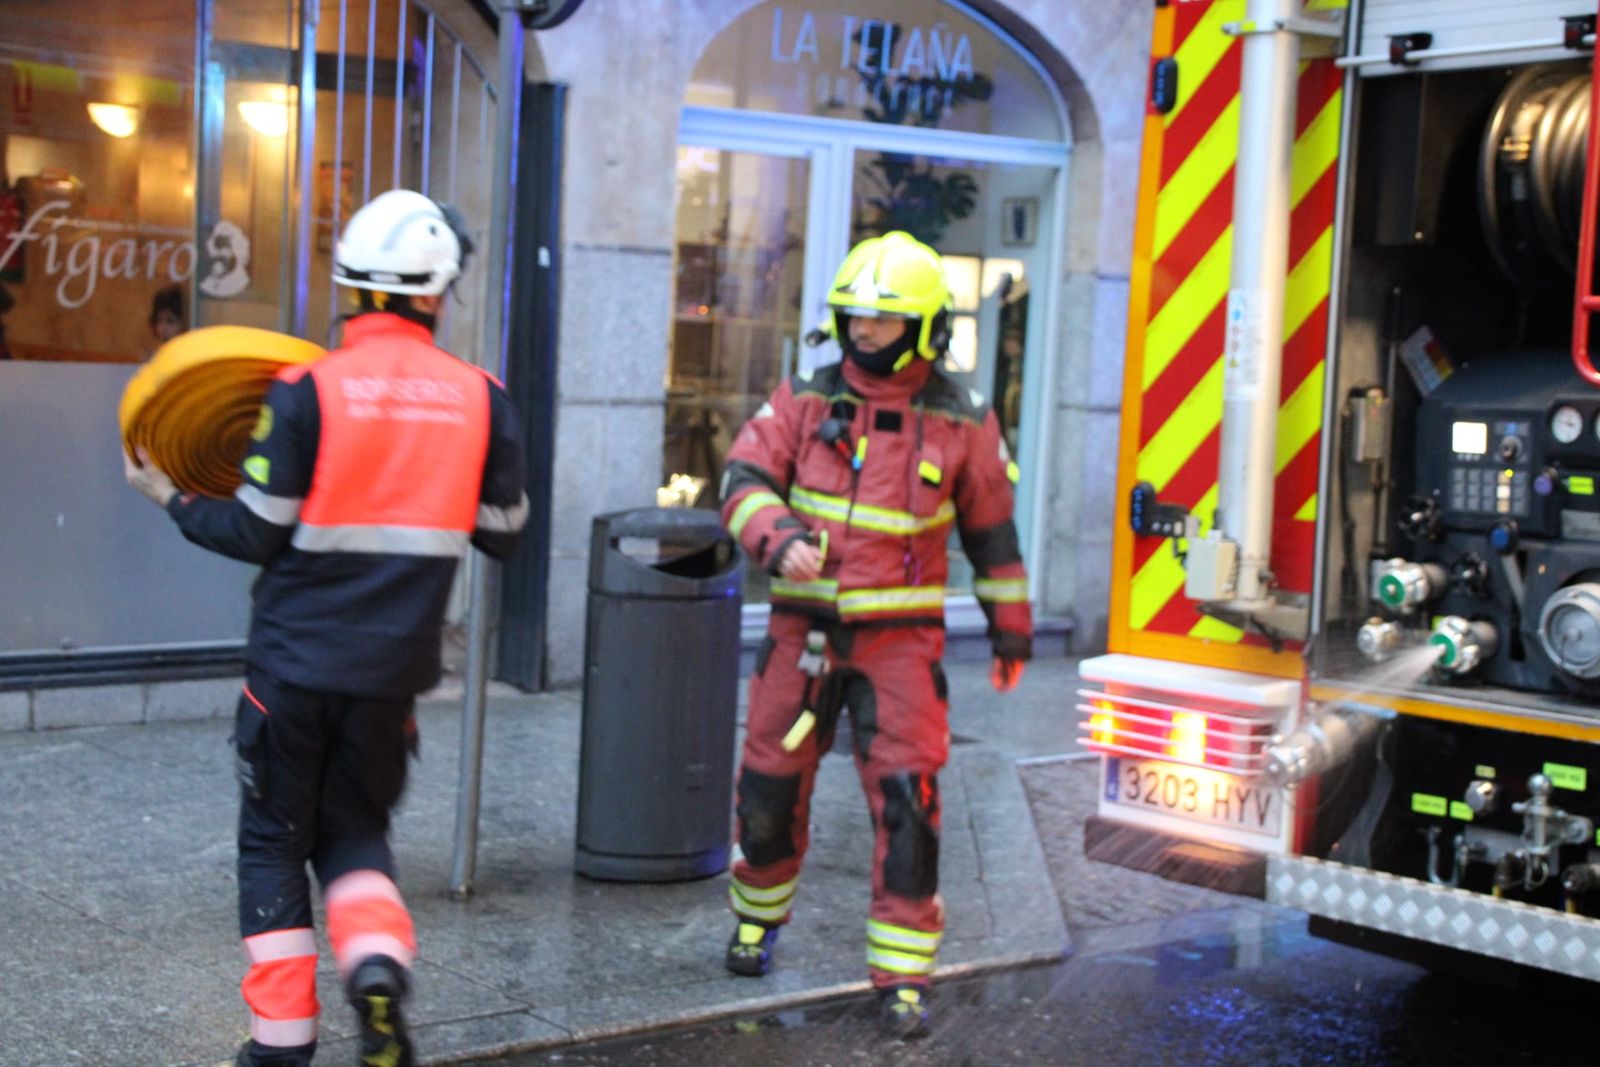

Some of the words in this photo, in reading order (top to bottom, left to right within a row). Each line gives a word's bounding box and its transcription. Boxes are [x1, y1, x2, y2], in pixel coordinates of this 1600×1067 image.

[771, 7, 819, 64] LA
[1126, 766, 1199, 812] 3203
[1213, 782, 1272, 827] HYV
